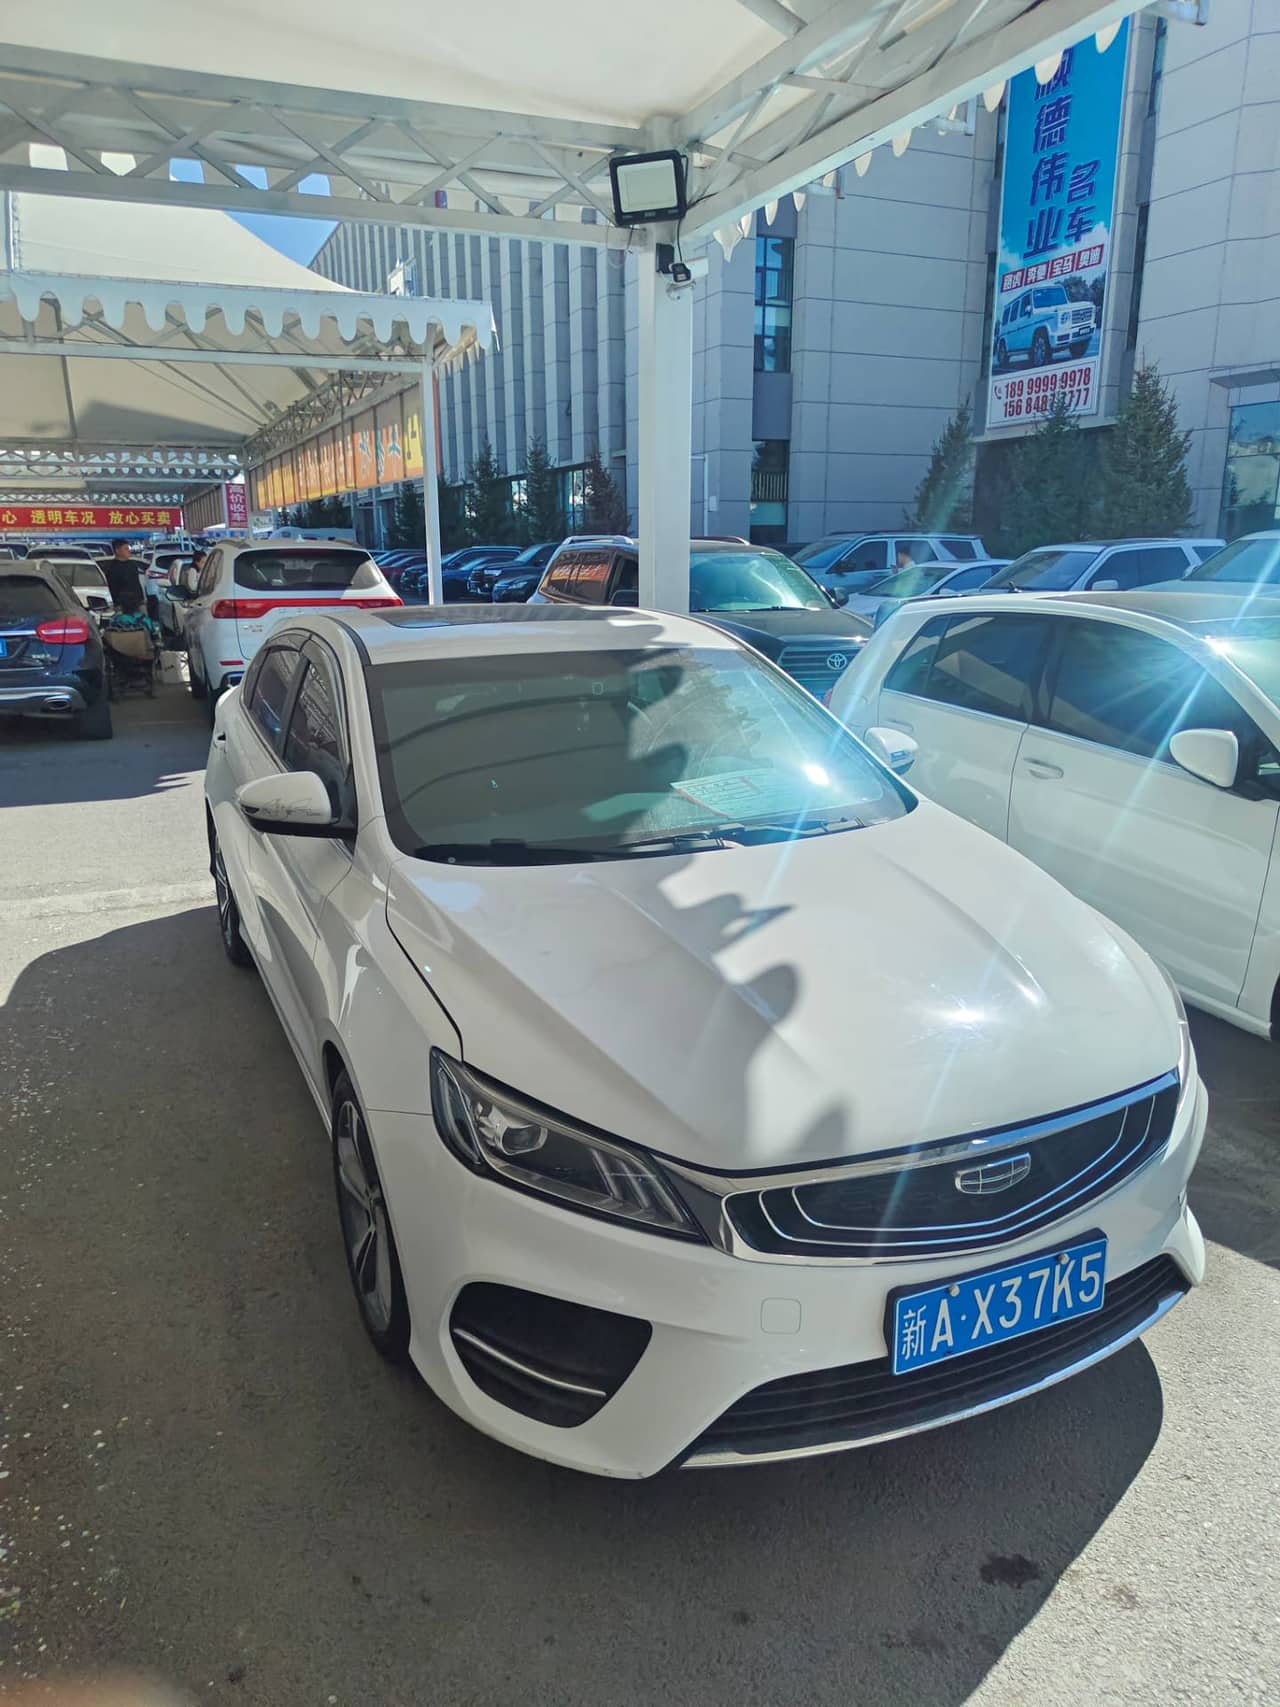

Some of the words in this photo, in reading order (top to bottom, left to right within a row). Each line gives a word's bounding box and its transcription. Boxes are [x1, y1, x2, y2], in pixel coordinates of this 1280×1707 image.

[1064, 160, 1100, 243] 名车
[1052, 255, 1073, 276] 宝马
[1005, 380, 1024, 399] 189
[1027, 374, 1057, 395] 9999
[1061, 367, 1091, 389] 9978
[1004, 399, 1022, 418] 156
[2, 510, 17, 524] 心
[31, 510, 96, 525] 透明车况
[109, 511, 171, 525] 放心买卖
